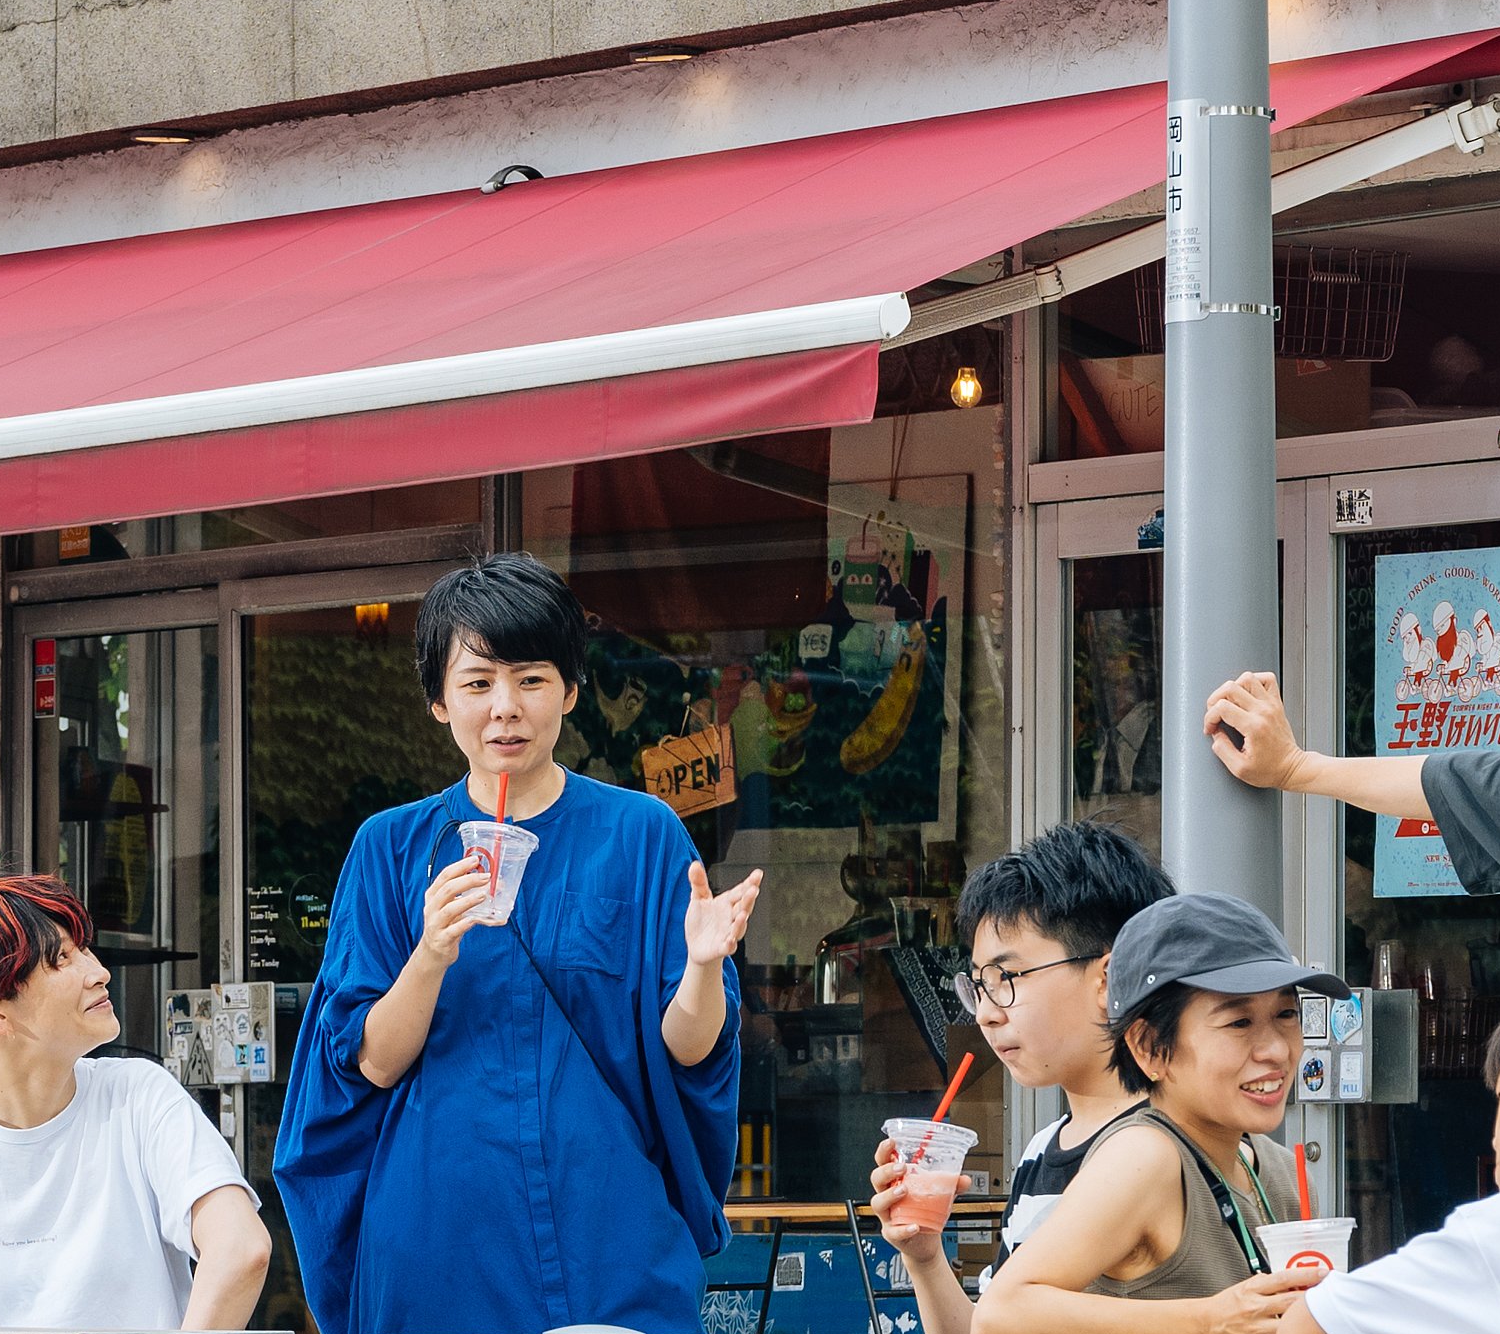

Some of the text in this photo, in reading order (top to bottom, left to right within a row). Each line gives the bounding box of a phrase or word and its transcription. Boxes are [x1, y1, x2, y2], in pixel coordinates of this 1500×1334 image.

[1168, 116, 1183, 214] 岡山市
[1110, 381, 1160, 425] CUTE
[1388, 607, 1404, 644] FOOD
[1408, 573, 1437, 601] DRINK
[1444, 567, 1476, 580] GOODS
[656, 751, 722, 799] OPEN
[1342, 1084, 1359, 1093] PULL
